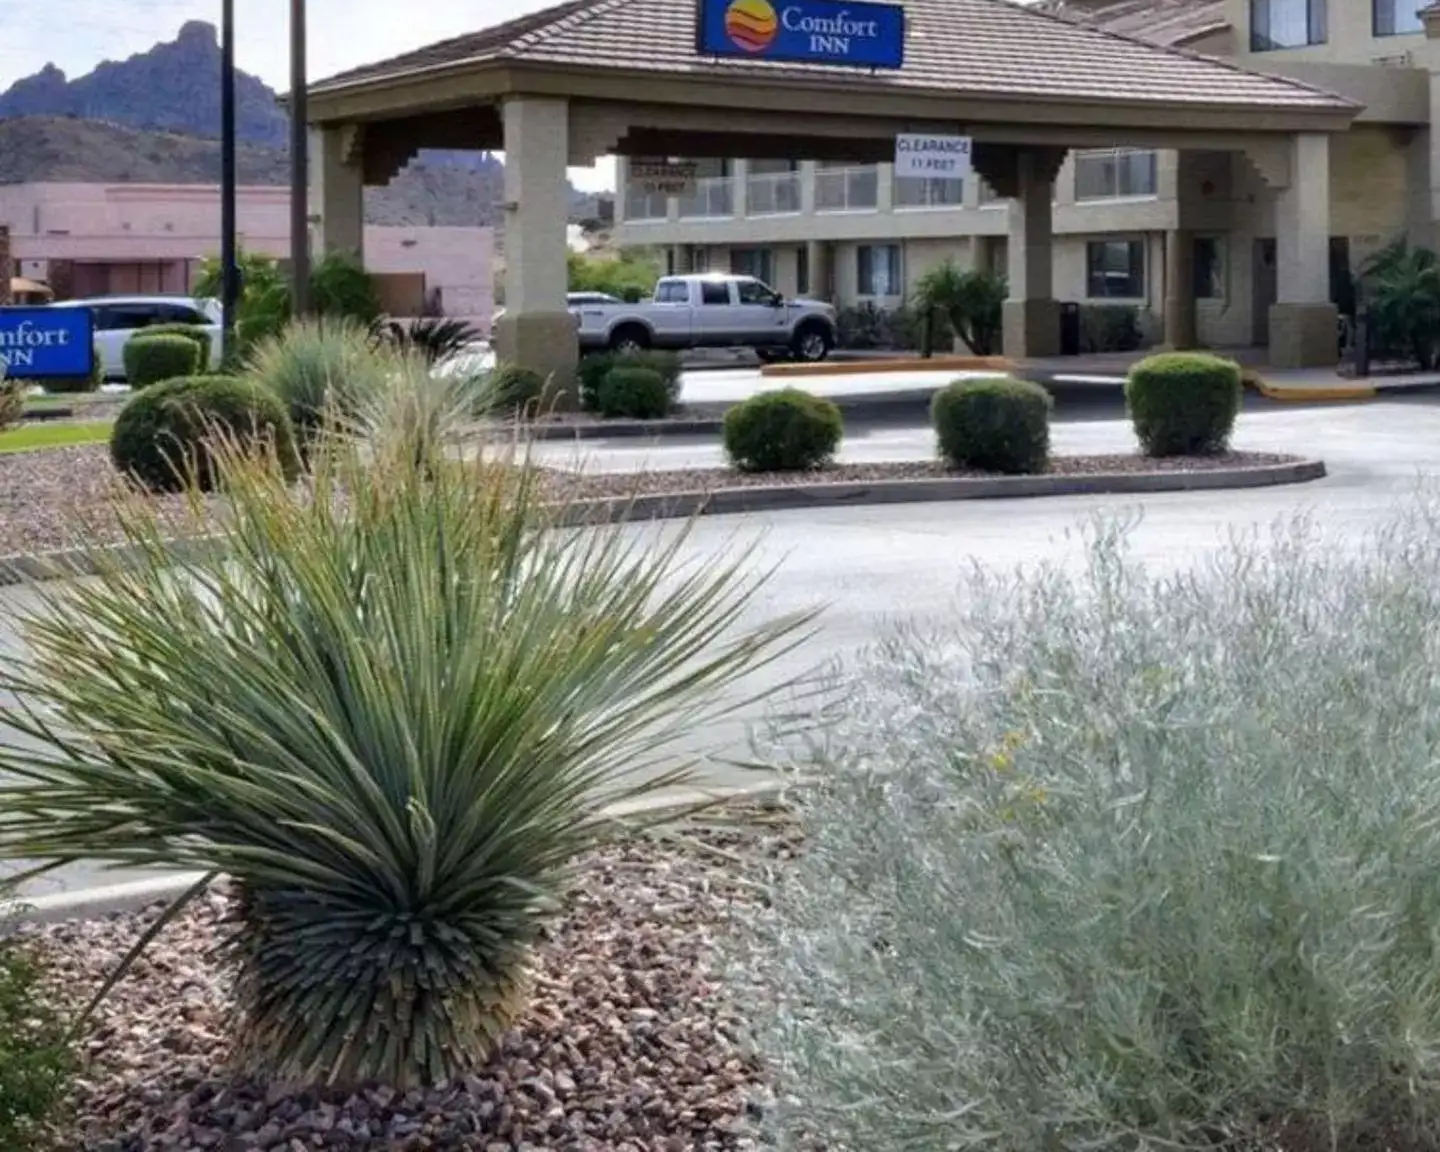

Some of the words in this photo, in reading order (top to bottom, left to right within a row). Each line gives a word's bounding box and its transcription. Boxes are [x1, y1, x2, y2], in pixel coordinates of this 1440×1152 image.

[782, 6, 878, 37] Comfort
[808, 35, 849, 55] INN
[898, 138, 968, 154] CLEARANCE
